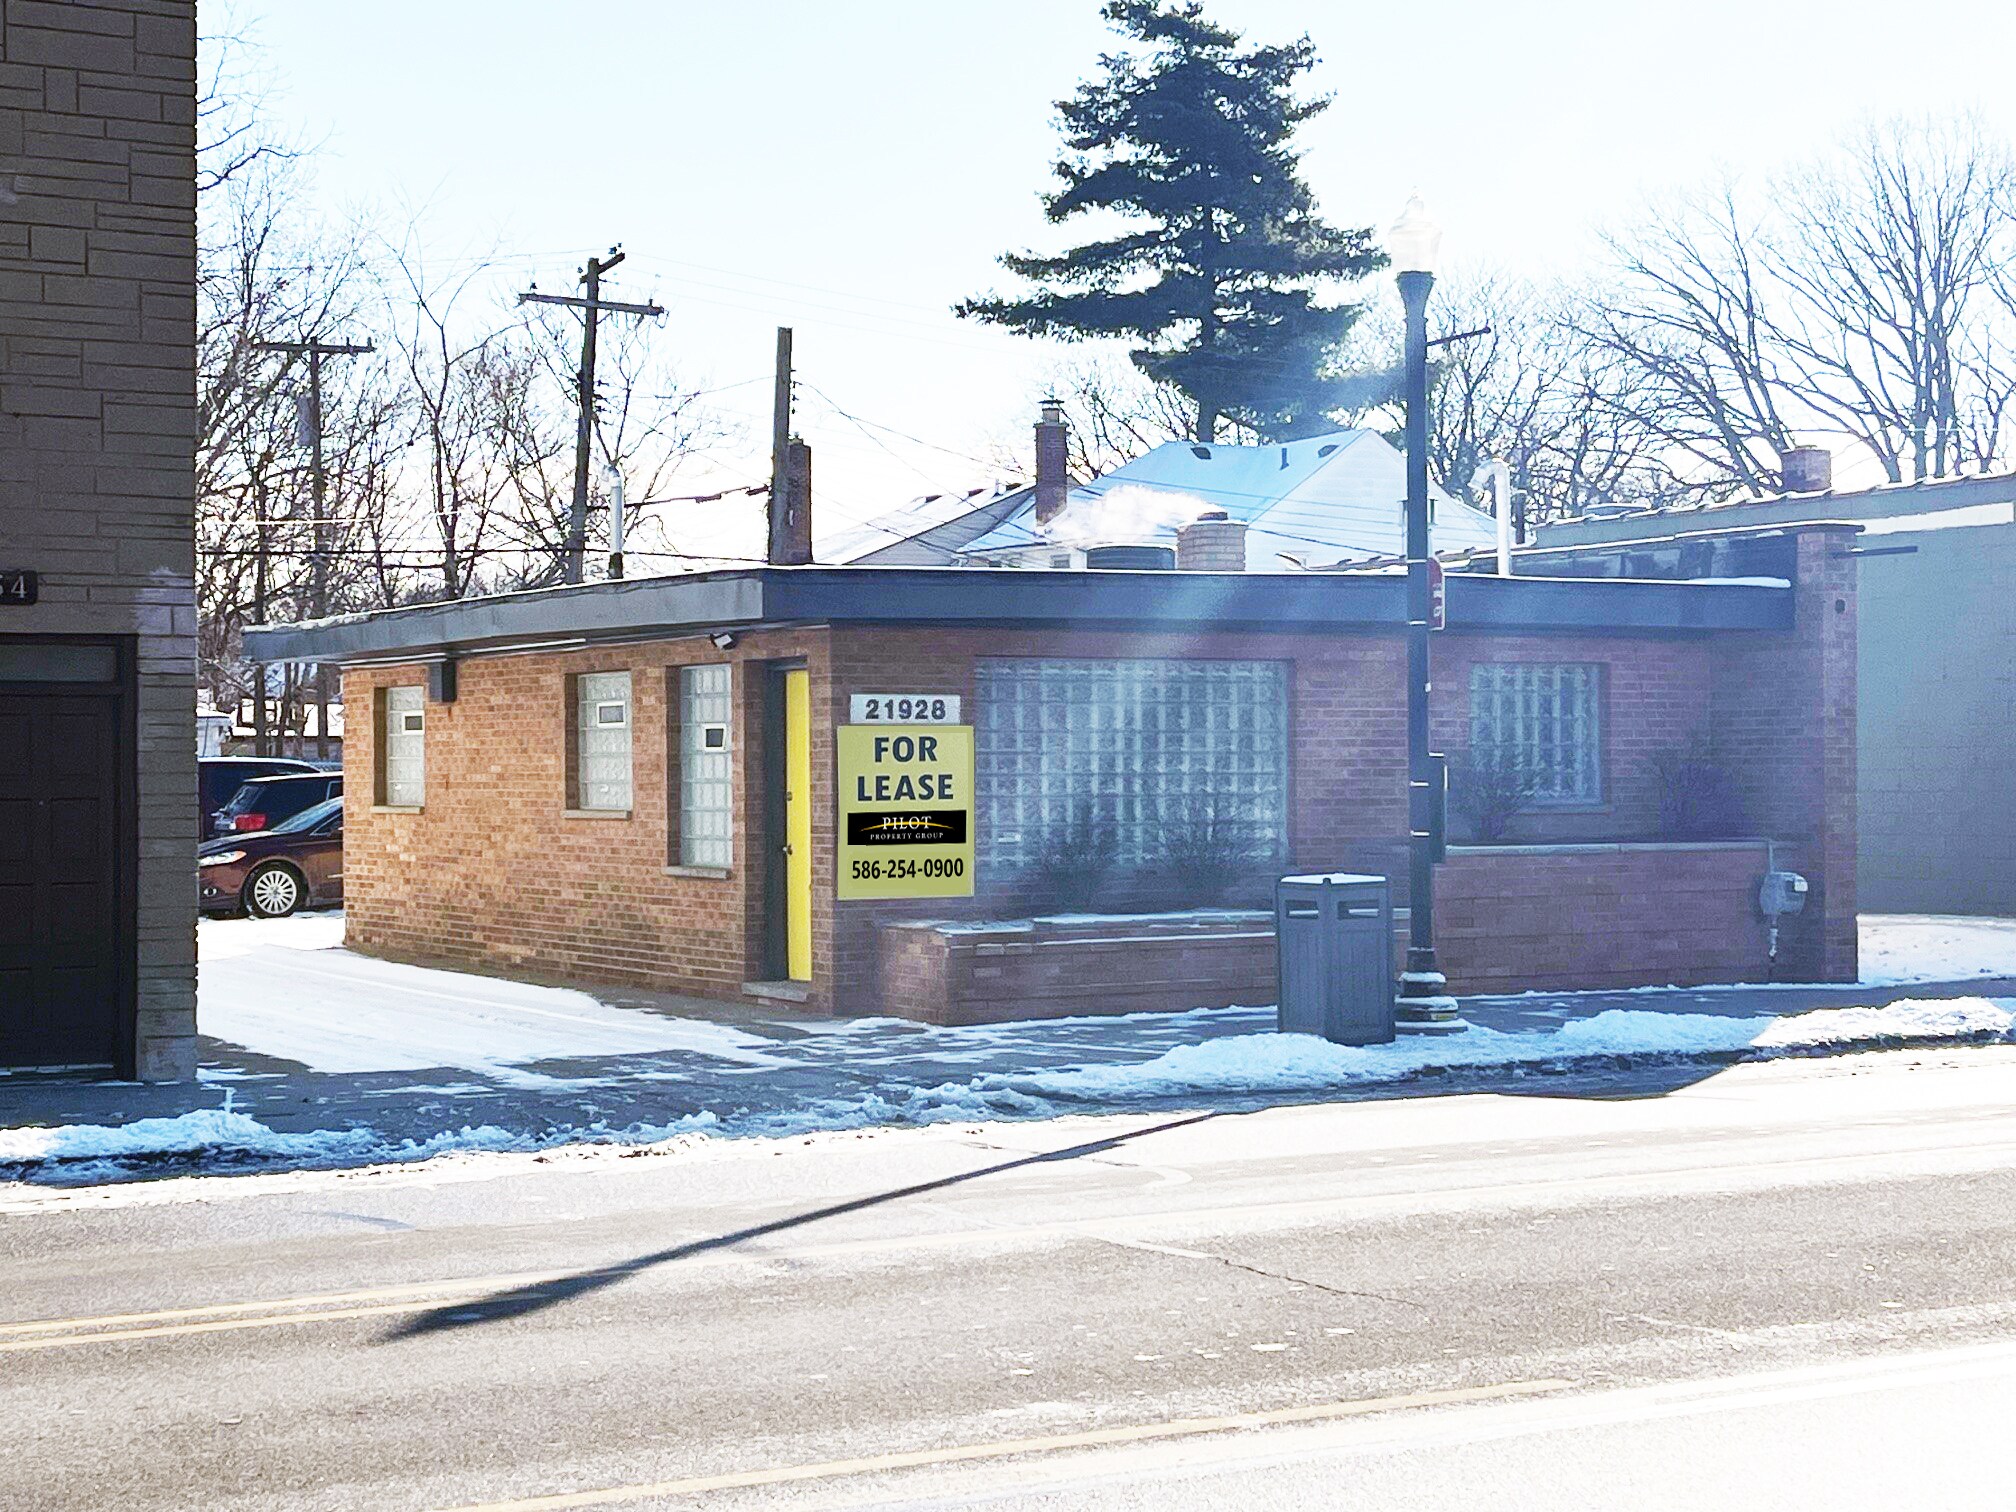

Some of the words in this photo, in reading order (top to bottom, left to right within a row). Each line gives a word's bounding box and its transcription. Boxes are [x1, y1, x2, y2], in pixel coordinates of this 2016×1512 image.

[0, 574, 27, 598] 4
[866, 699, 946, 719] 21928
[874, 736, 938, 762] FOR
[857, 774, 954, 801] LEASE
[882, 815, 932, 830] PILOT
[852, 858, 964, 879] 586-254-0900
